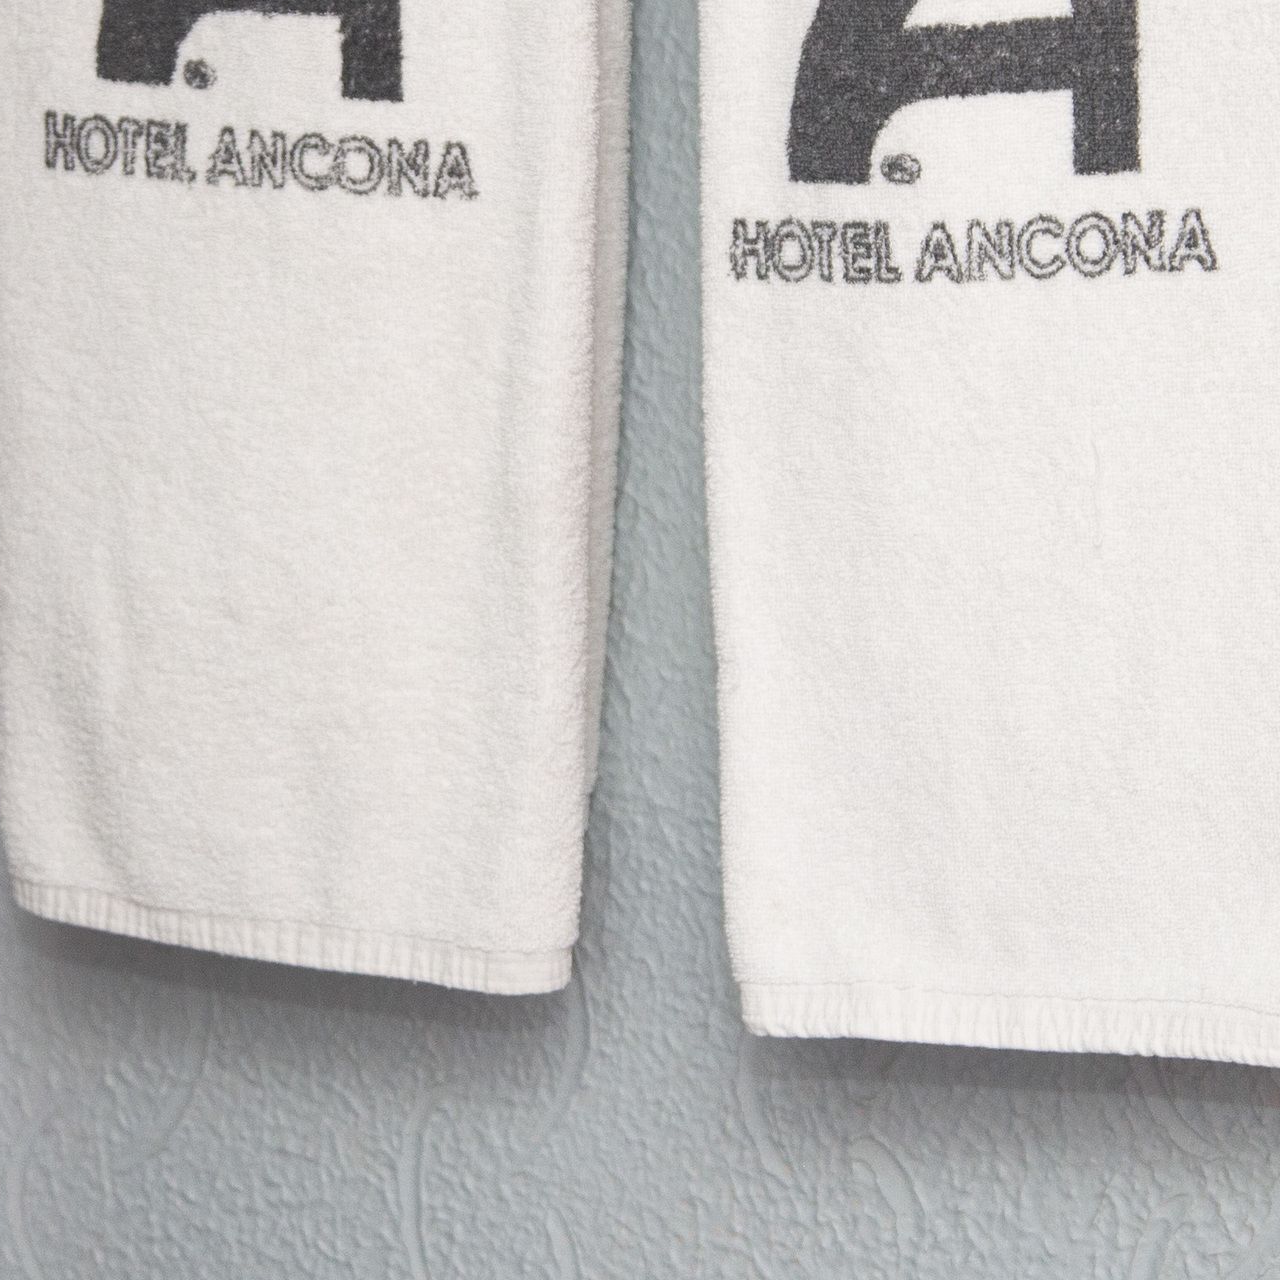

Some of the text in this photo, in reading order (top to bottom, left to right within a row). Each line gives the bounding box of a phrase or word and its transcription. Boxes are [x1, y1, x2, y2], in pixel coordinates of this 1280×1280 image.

[44, 110, 480, 200] HOTEL ANCONA
[730, 207, 1219, 284] HOTEL ANCONA
